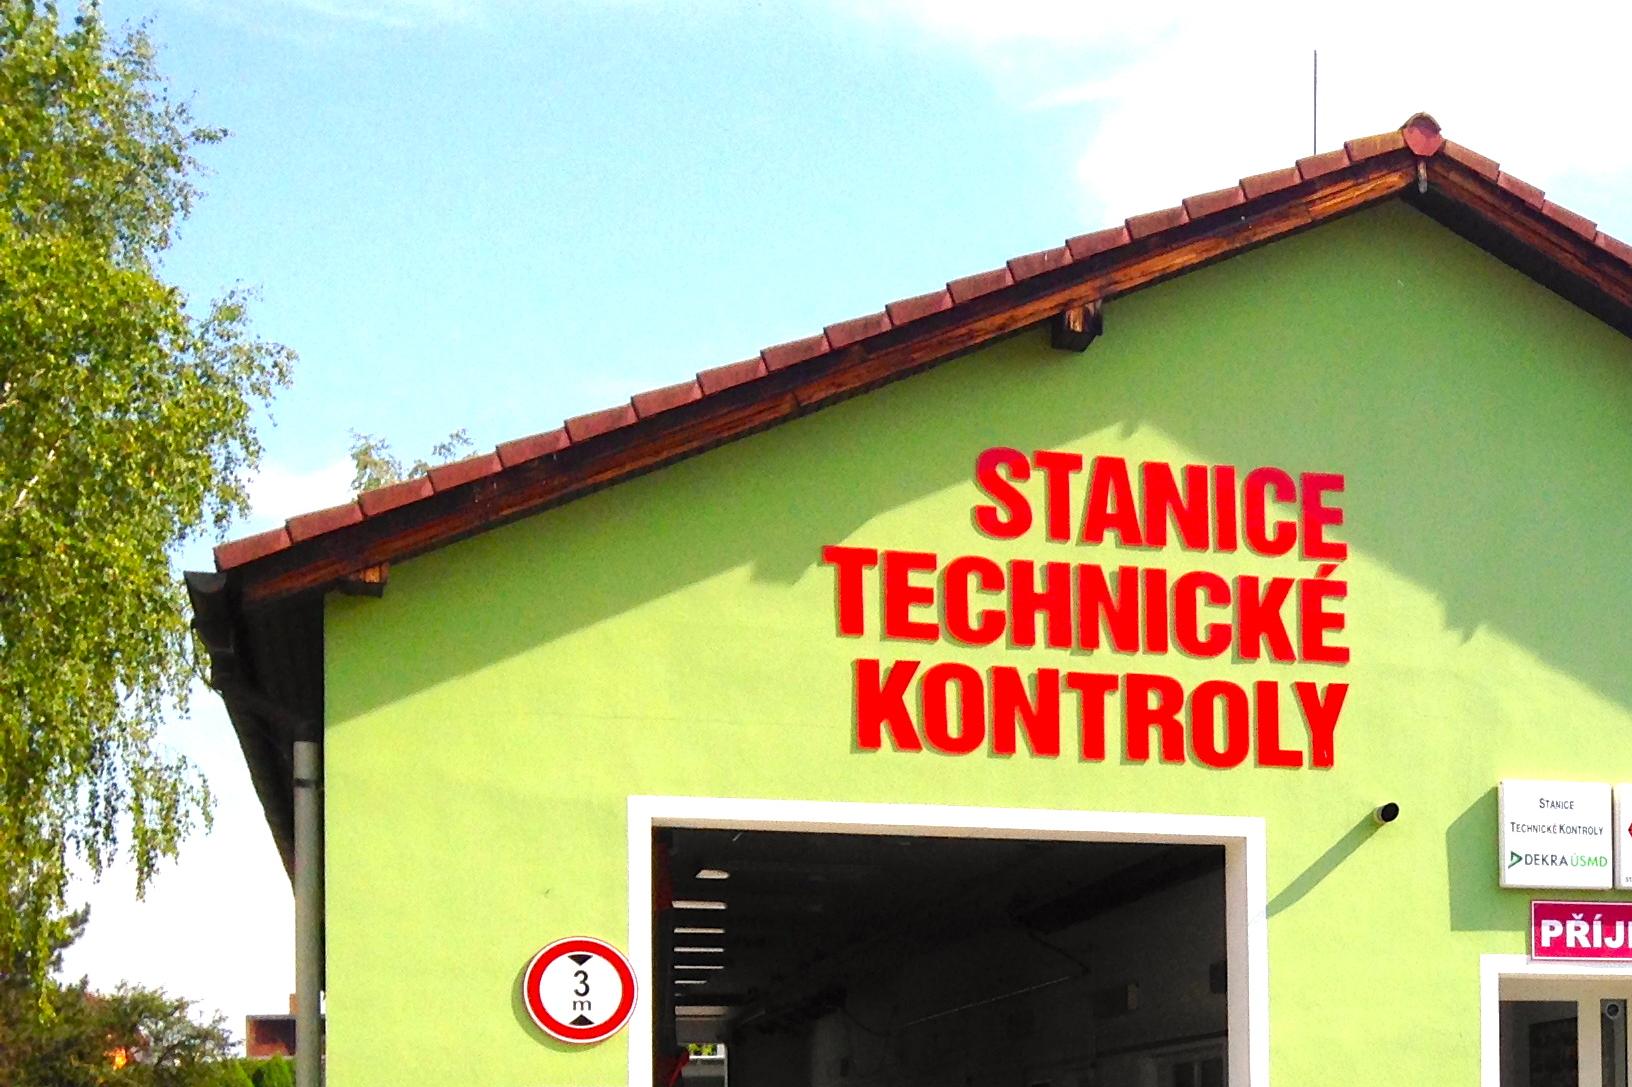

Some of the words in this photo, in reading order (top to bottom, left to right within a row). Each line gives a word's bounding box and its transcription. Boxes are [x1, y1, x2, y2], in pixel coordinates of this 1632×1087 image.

[973, 447, 1347, 560] STANICE
[822, 545, 1349, 663] TECHNICKÉ
[852, 658, 1349, 770] KONTROLY
[1524, 853, 1568, 867] DEKRA
[572, 1000, 592, 1011] m
[573, 970, 590, 997] 3
